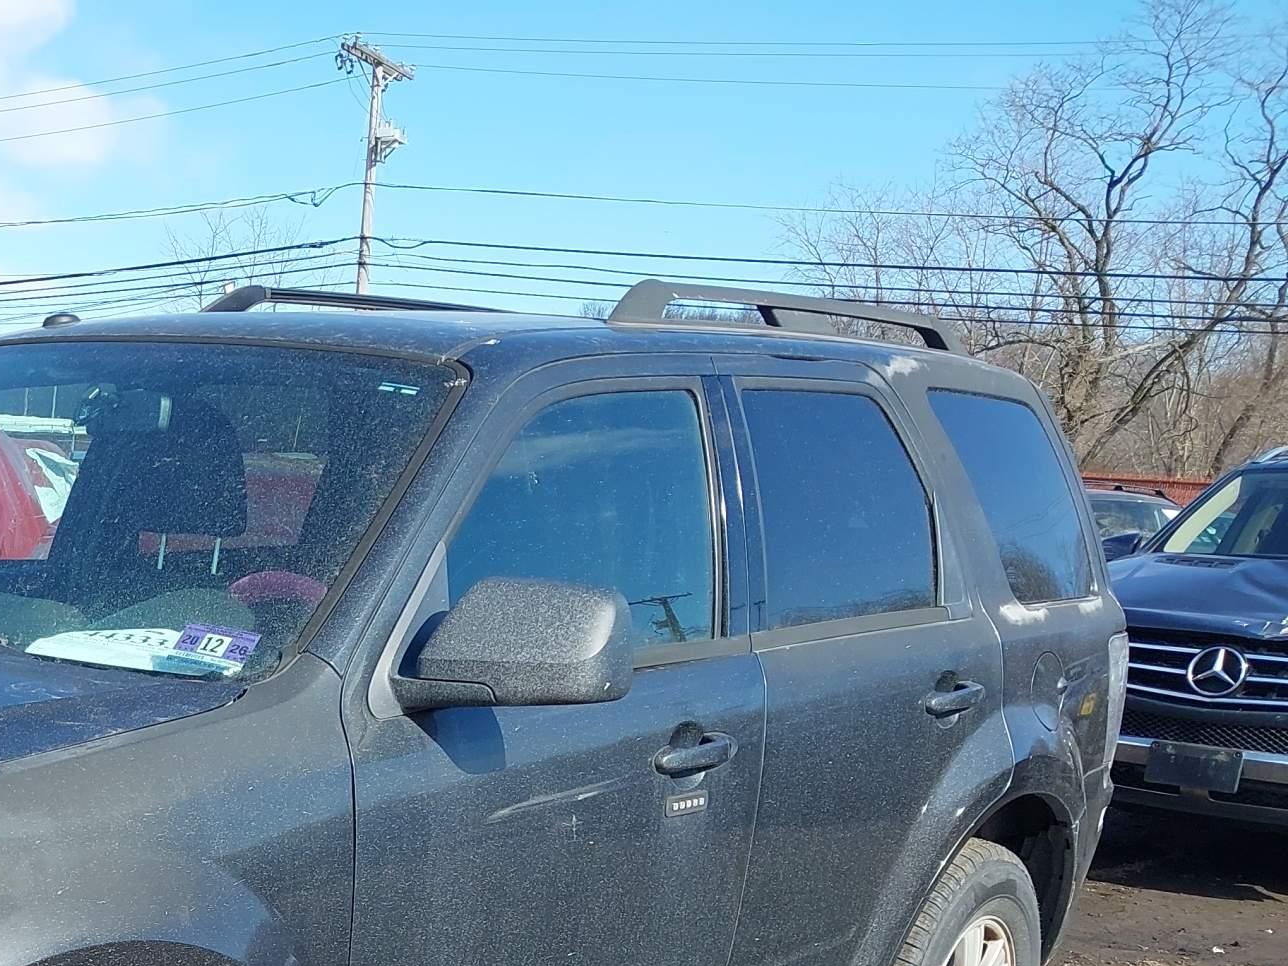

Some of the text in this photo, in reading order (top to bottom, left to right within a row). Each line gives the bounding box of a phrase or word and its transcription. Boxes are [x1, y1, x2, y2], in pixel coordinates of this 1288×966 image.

[181, 634, 249, 656] 20 12 26
